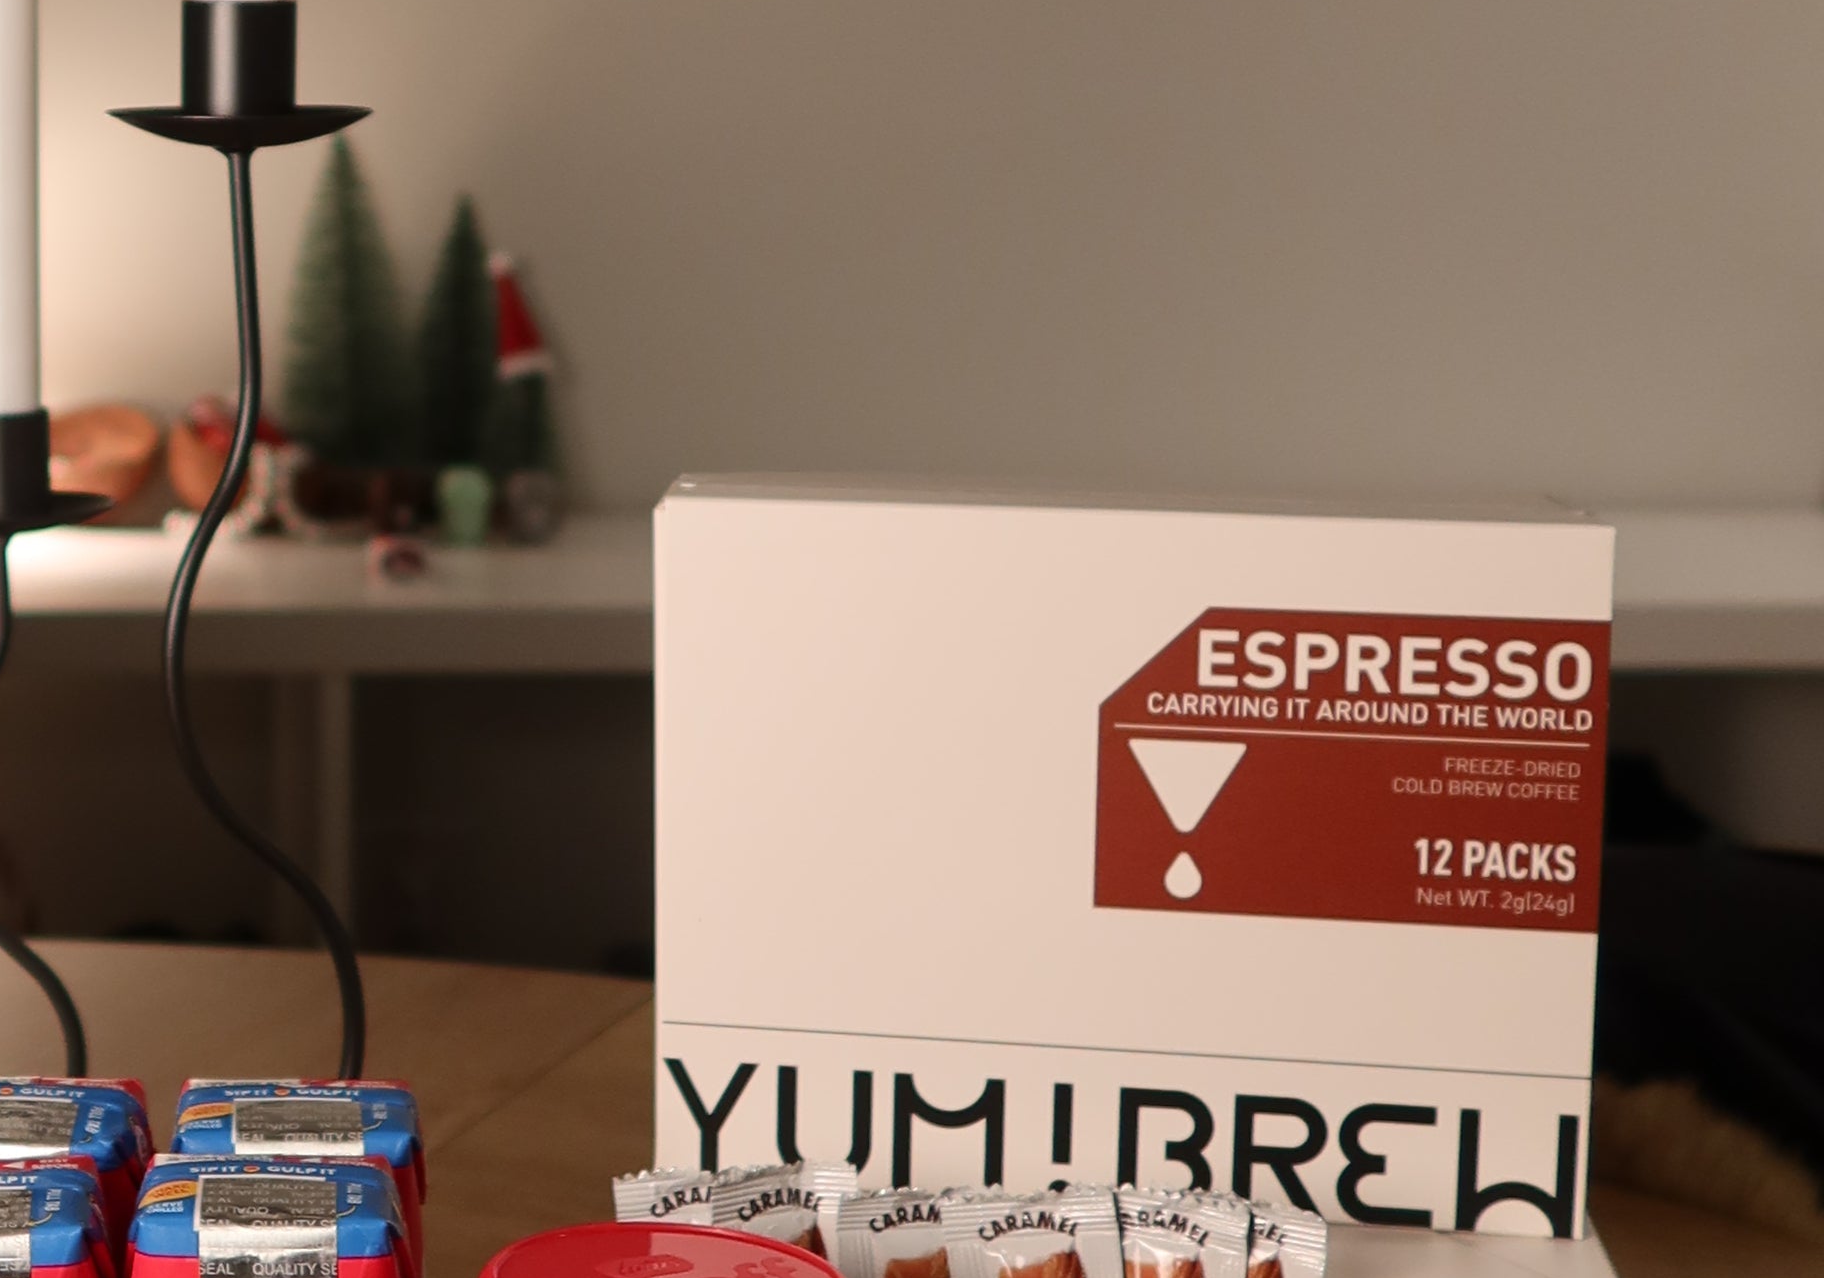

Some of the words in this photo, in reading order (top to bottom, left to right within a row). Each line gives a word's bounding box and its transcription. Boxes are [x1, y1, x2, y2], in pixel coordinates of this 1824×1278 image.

[1197, 627, 1594, 703] ESPRESSO
[1146, 692, 1279, 720] CARRYING
[1285, 699, 1310, 720] IT
[1315, 699, 1429, 725] AROUND
[1437, 704, 1489, 728] THE
[1495, 707, 1594, 732] WORLD
[1445, 757, 1582, 779] FREEZE-DRIED
[1392, 777, 1444, 796] COLD
[1448, 780, 1503, 799] BREW
[1507, 782, 1582, 801] COFFEE
[1414, 838, 1453, 877] 12
[1463, 839, 1578, 883] PACKS
[1416, 887, 1452, 907] Net
[1457, 889, 1495, 910] WT.
[189, 1165, 220, 1173] SIP
[267, 1165, 316, 1174] GULP
[650, 1186, 712, 1218] CARA
[737, 1186, 820, 1222] CARAMEL
[978, 1211, 1076, 1242] CARAMEL
[252, 1262, 317, 1277] QUALITY
